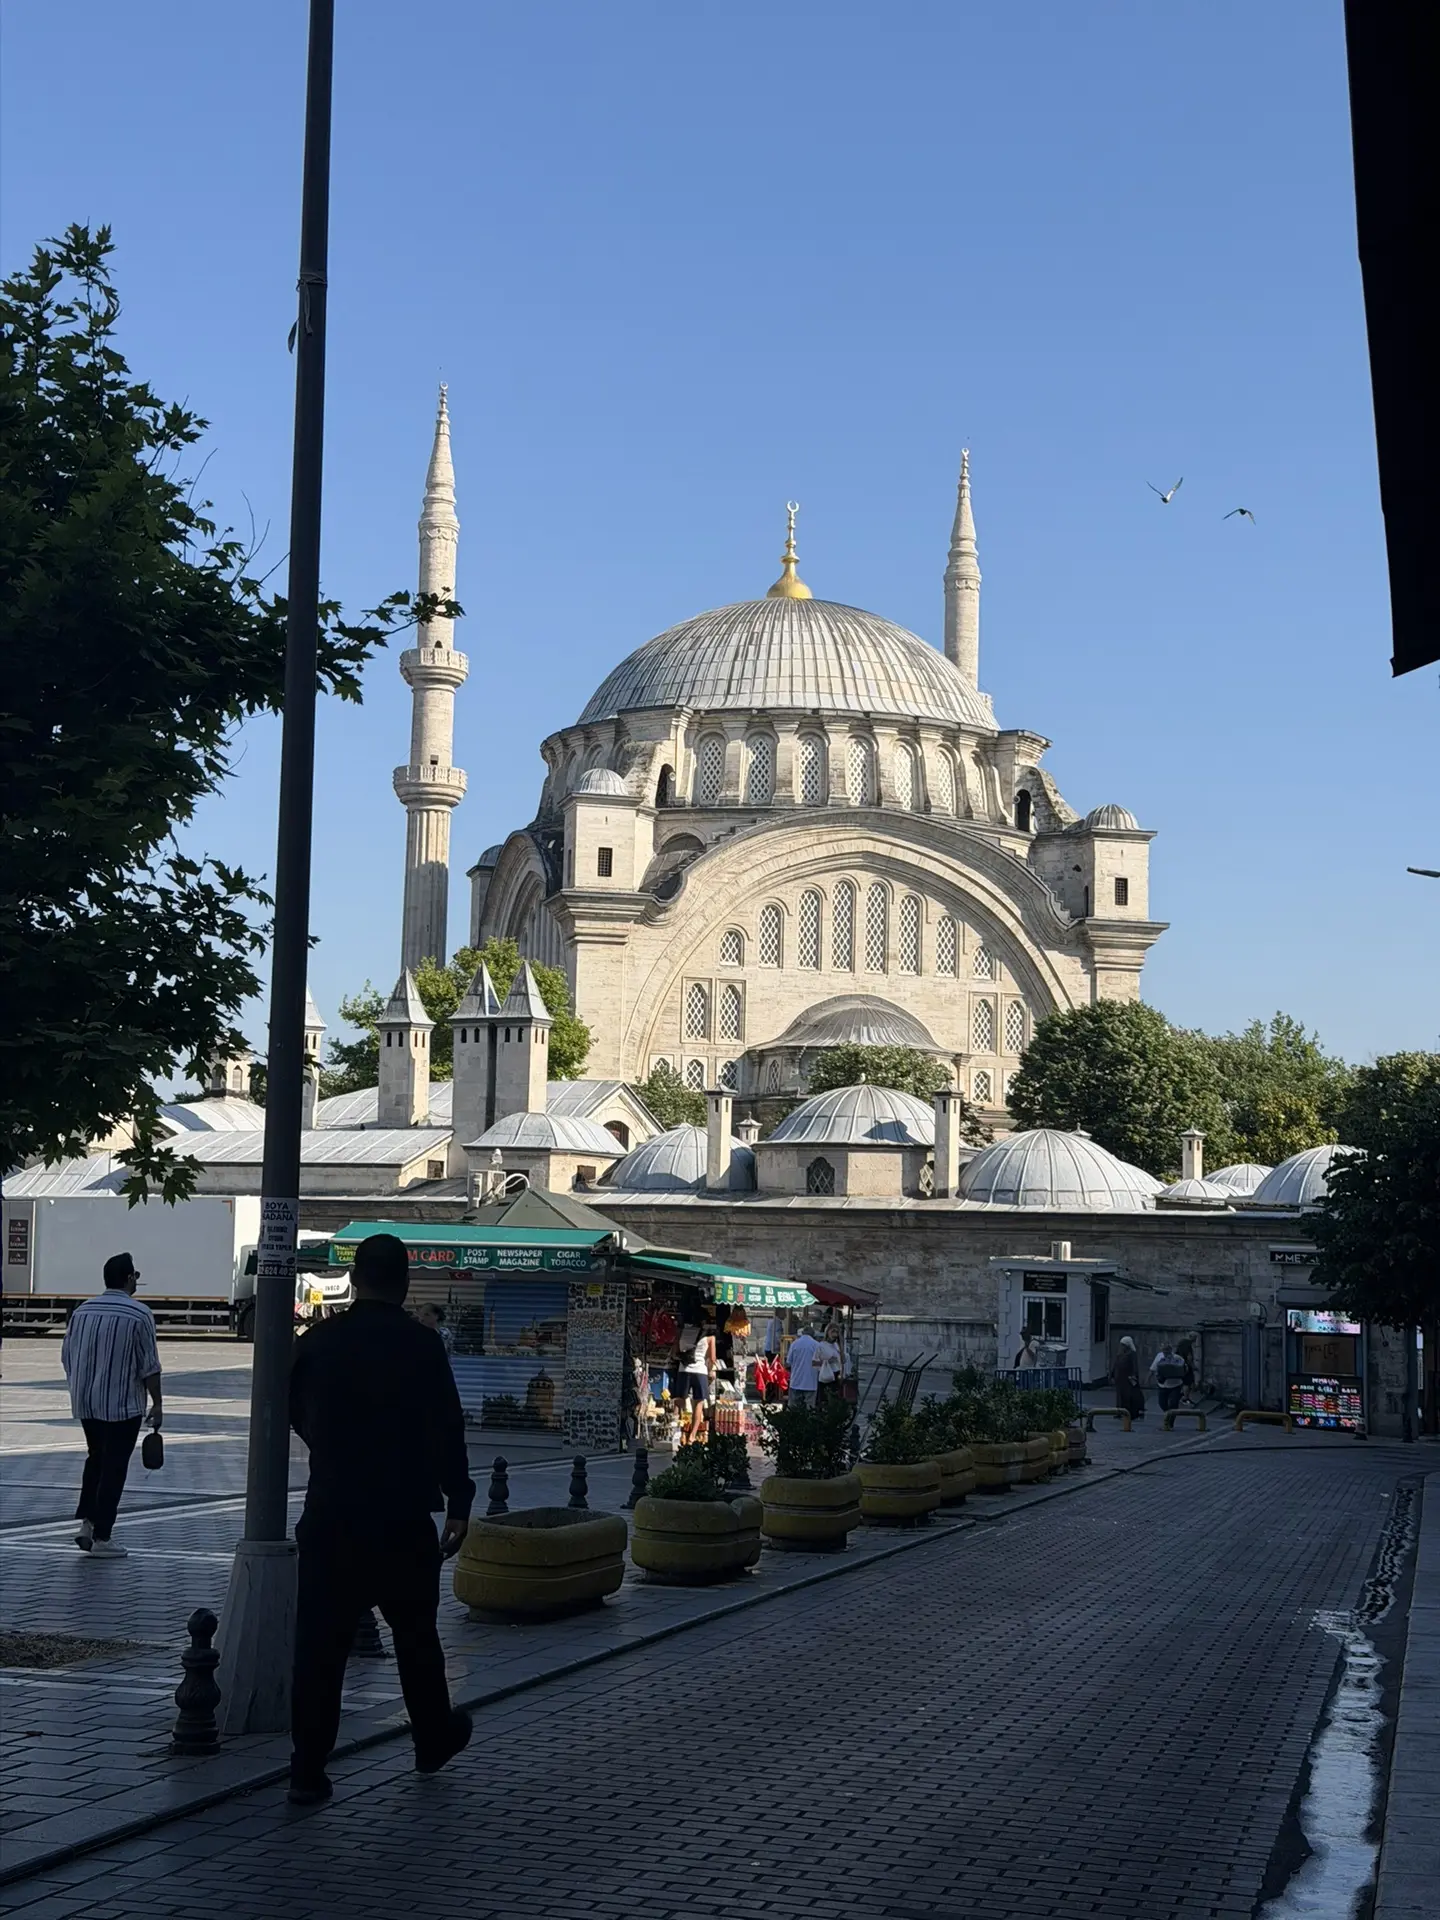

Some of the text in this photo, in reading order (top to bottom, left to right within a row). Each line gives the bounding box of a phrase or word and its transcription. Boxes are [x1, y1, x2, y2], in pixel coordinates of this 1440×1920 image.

[420, 1250, 455, 1262] CARD
[467, 1248, 487, 1256] POST
[496, 1249, 543, 1257] NEWSPAPER
[556, 1250, 581, 1258] CIGAR
[463, 1256, 490, 1265] STAMP
[499, 1258, 540, 1266] MAGAZINE
[550, 1258, 587, 1267] TOBACCO
